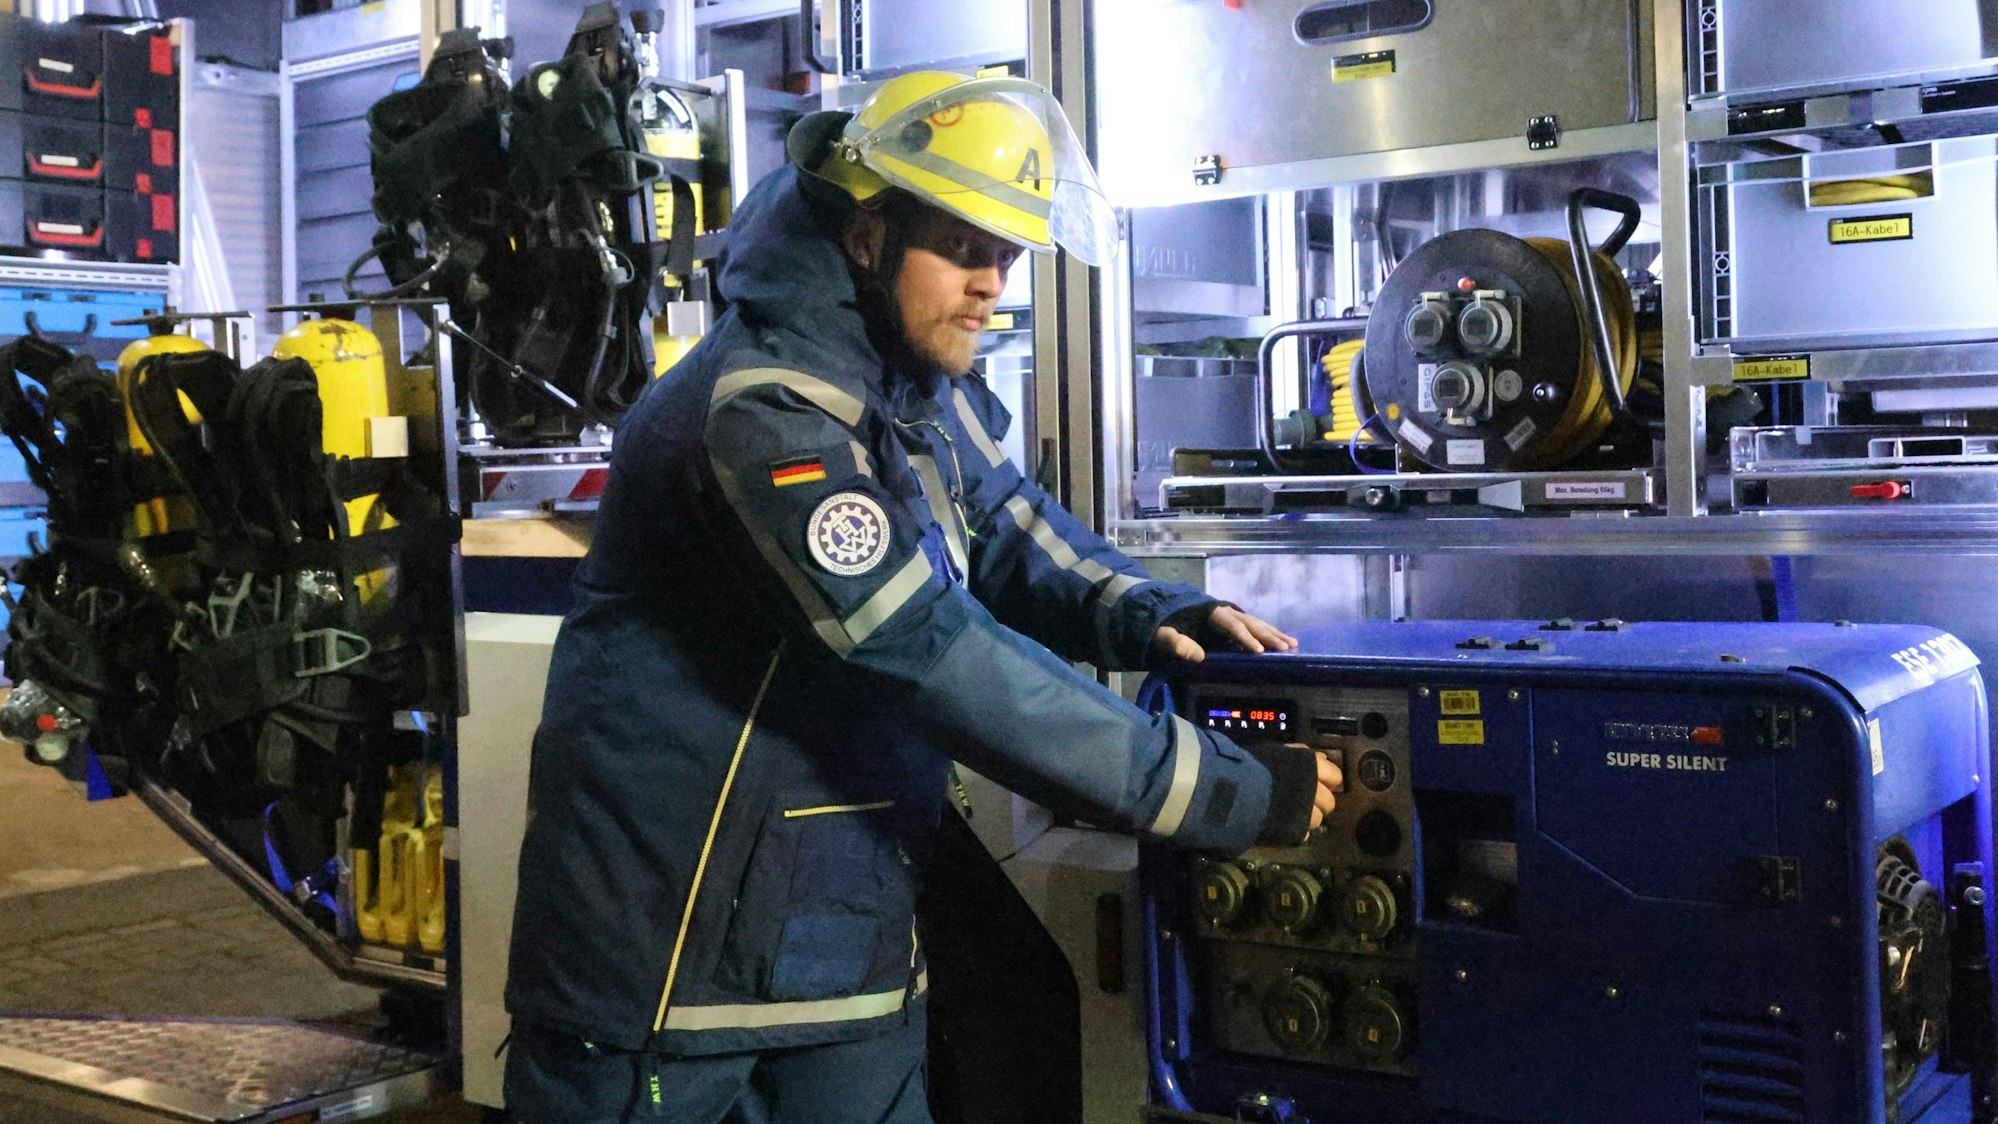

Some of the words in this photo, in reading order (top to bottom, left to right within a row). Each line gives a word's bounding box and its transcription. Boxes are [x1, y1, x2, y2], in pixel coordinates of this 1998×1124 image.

[1016, 147, 1040, 191] A
[1840, 222, 1899, 237] 16A-Kabel
[1740, 363, 1798, 376] 16A-Kabel
[1570, 486, 1599, 495] Beladung
[809, 494, 858, 536] BUNDESANSTALT
[829, 558, 877, 574] TECHNISCHES
[1889, 646, 1938, 682] ESE
[1250, 711, 1275, 721] 0835
[1606, 751, 1662, 769] SUPER
[1666, 754, 1728, 772] SILENT
[955, 783, 971, 807] THW
[650, 1075, 662, 1103] THW
